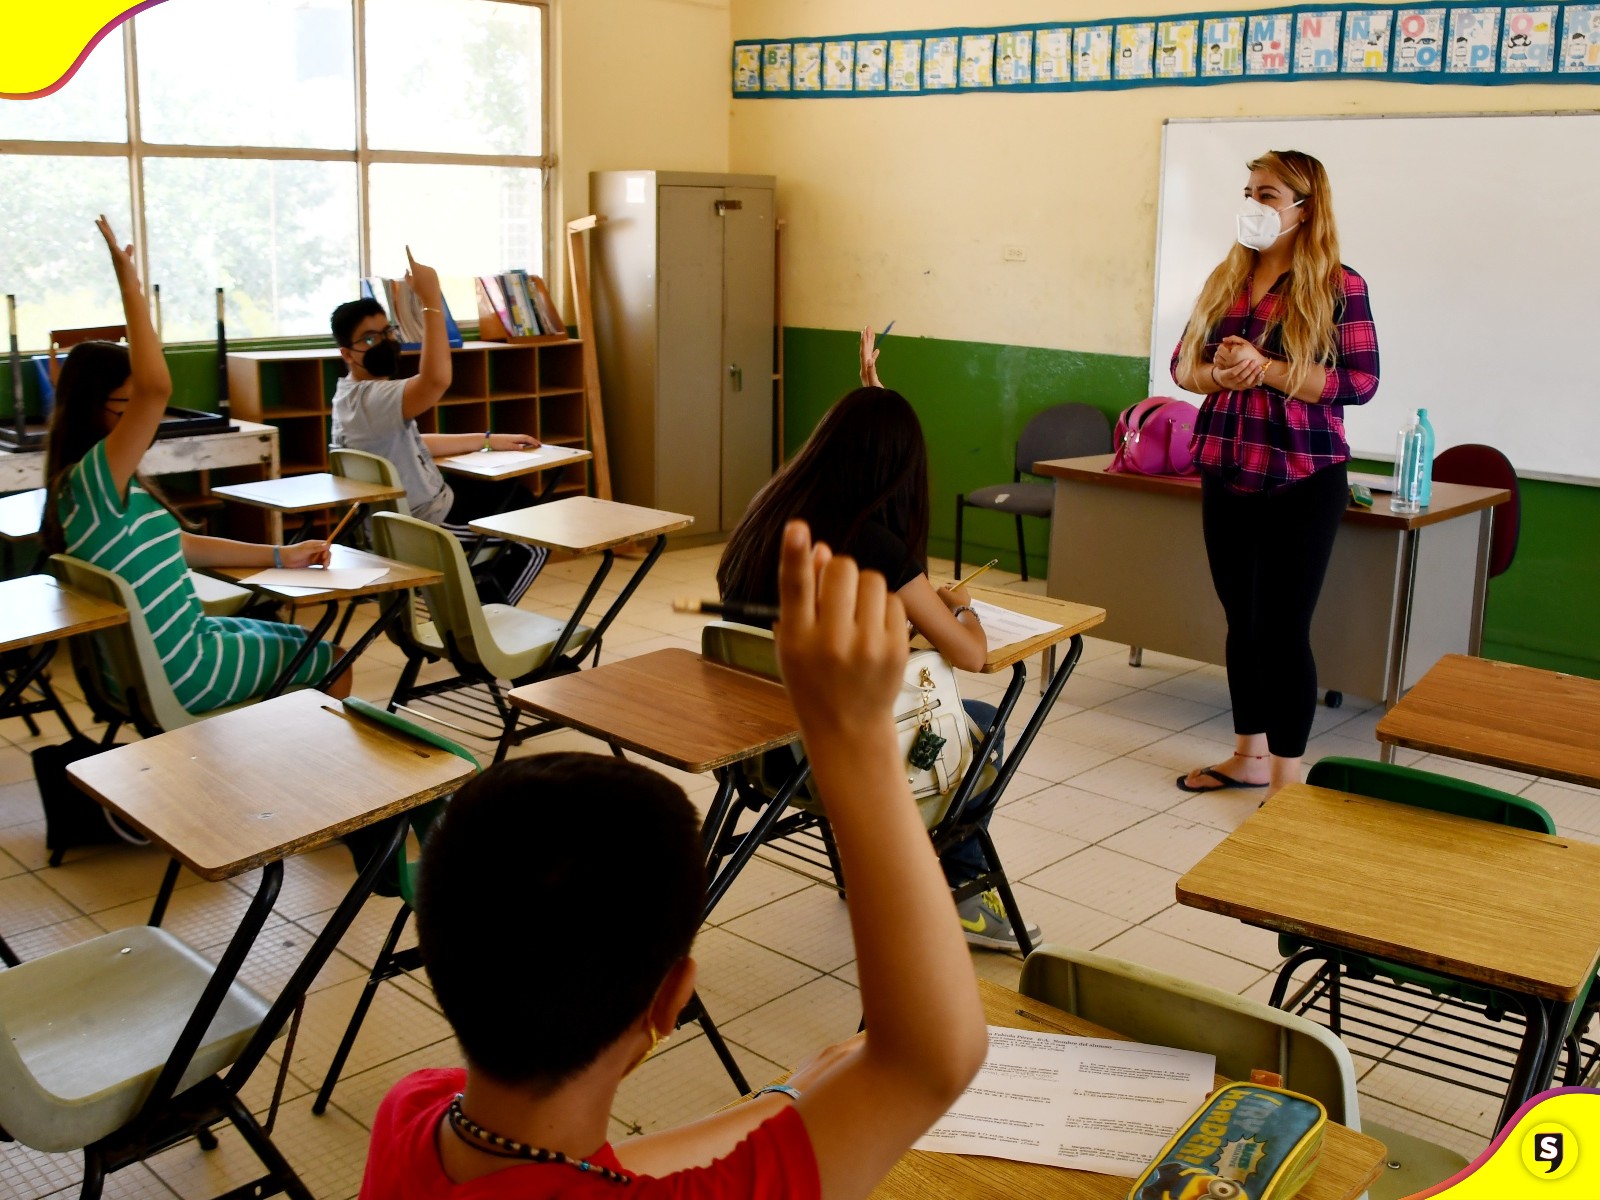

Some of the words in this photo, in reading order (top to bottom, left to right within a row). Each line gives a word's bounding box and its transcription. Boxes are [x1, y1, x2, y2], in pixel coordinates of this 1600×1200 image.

[1253, 20, 1275, 41] M
[1302, 17, 1322, 39] N
[1401, 15, 1425, 38] O
[1456, 13, 1477, 37] P
[1569, 11, 1592, 35] R
[1081, 32, 1092, 52] J
[1121, 29, 1136, 48] K
[1163, 25, 1177, 45] L
[768, 50, 778, 65] B
[1262, 53, 1285, 67] m
[1314, 48, 1333, 66] n
[1416, 46, 1437, 66] o
[1469, 44, 1490, 66] p
[1014, 60, 1028, 77] h
[1173, 1089, 1252, 1165] HARDER!
